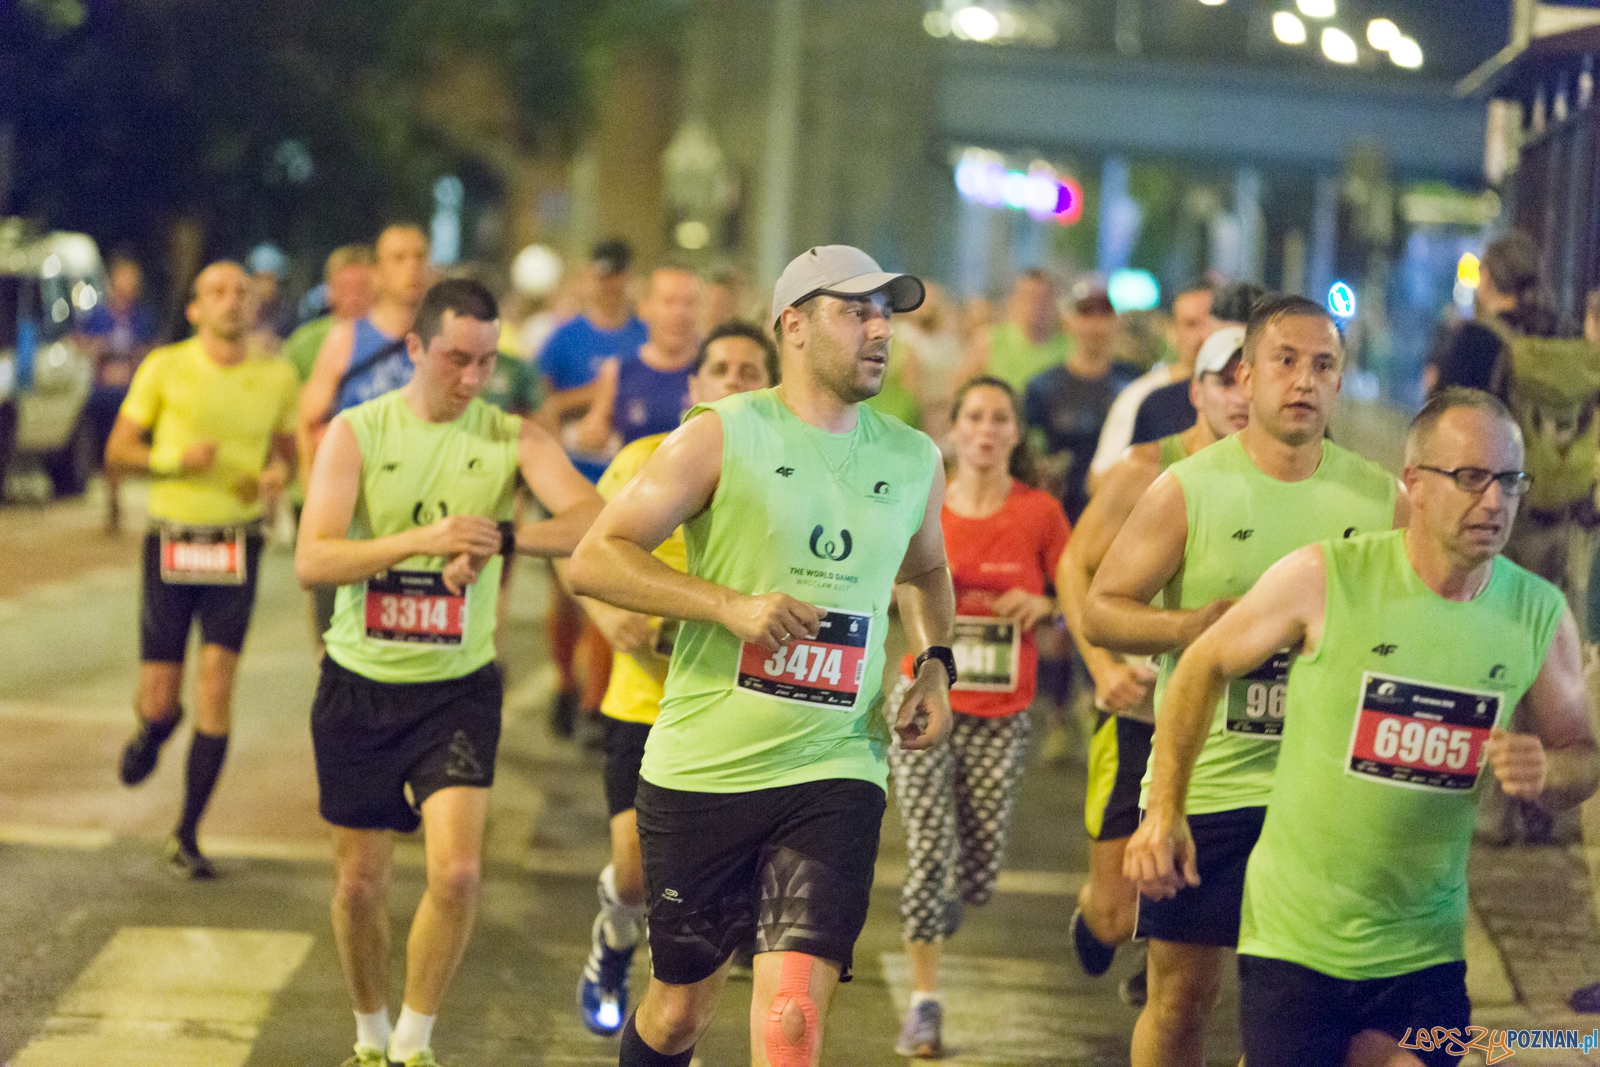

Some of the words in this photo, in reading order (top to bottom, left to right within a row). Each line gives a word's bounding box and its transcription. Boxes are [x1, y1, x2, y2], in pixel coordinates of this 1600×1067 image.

[775, 466, 795, 477] 4F
[1231, 529, 1254, 541] 4F
[789, 567, 805, 576] THE
[806, 569, 833, 580] WORLD
[835, 573, 858, 584] GAMES
[380, 595, 448, 630] 3314
[1371, 643, 1398, 656] 4F
[763, 643, 843, 686] 3474
[1245, 683, 1287, 719] 96
[1373, 717, 1472, 770] 6965
